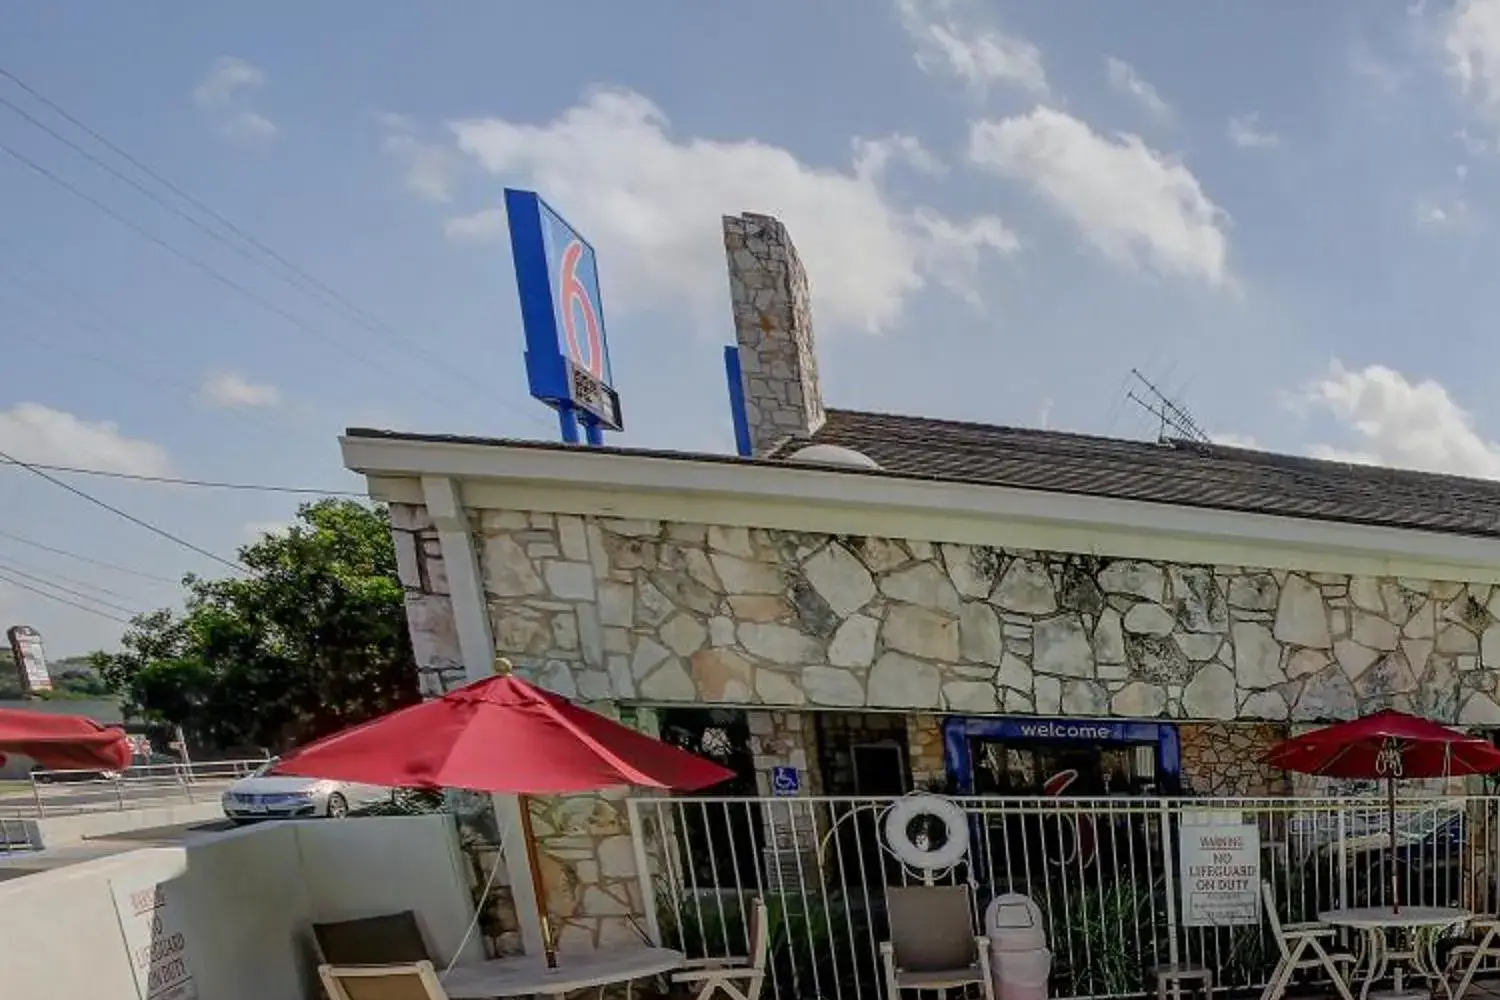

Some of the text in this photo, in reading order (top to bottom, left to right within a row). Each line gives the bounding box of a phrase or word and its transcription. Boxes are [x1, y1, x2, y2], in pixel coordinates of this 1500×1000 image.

[560, 240, 602, 381] 6
[1021, 722, 1111, 739] welcome
[1213, 853, 1232, 865] NO
[1189, 866, 1257, 877] LIFEGUARD
[1196, 880, 1249, 890] ON DUTY
